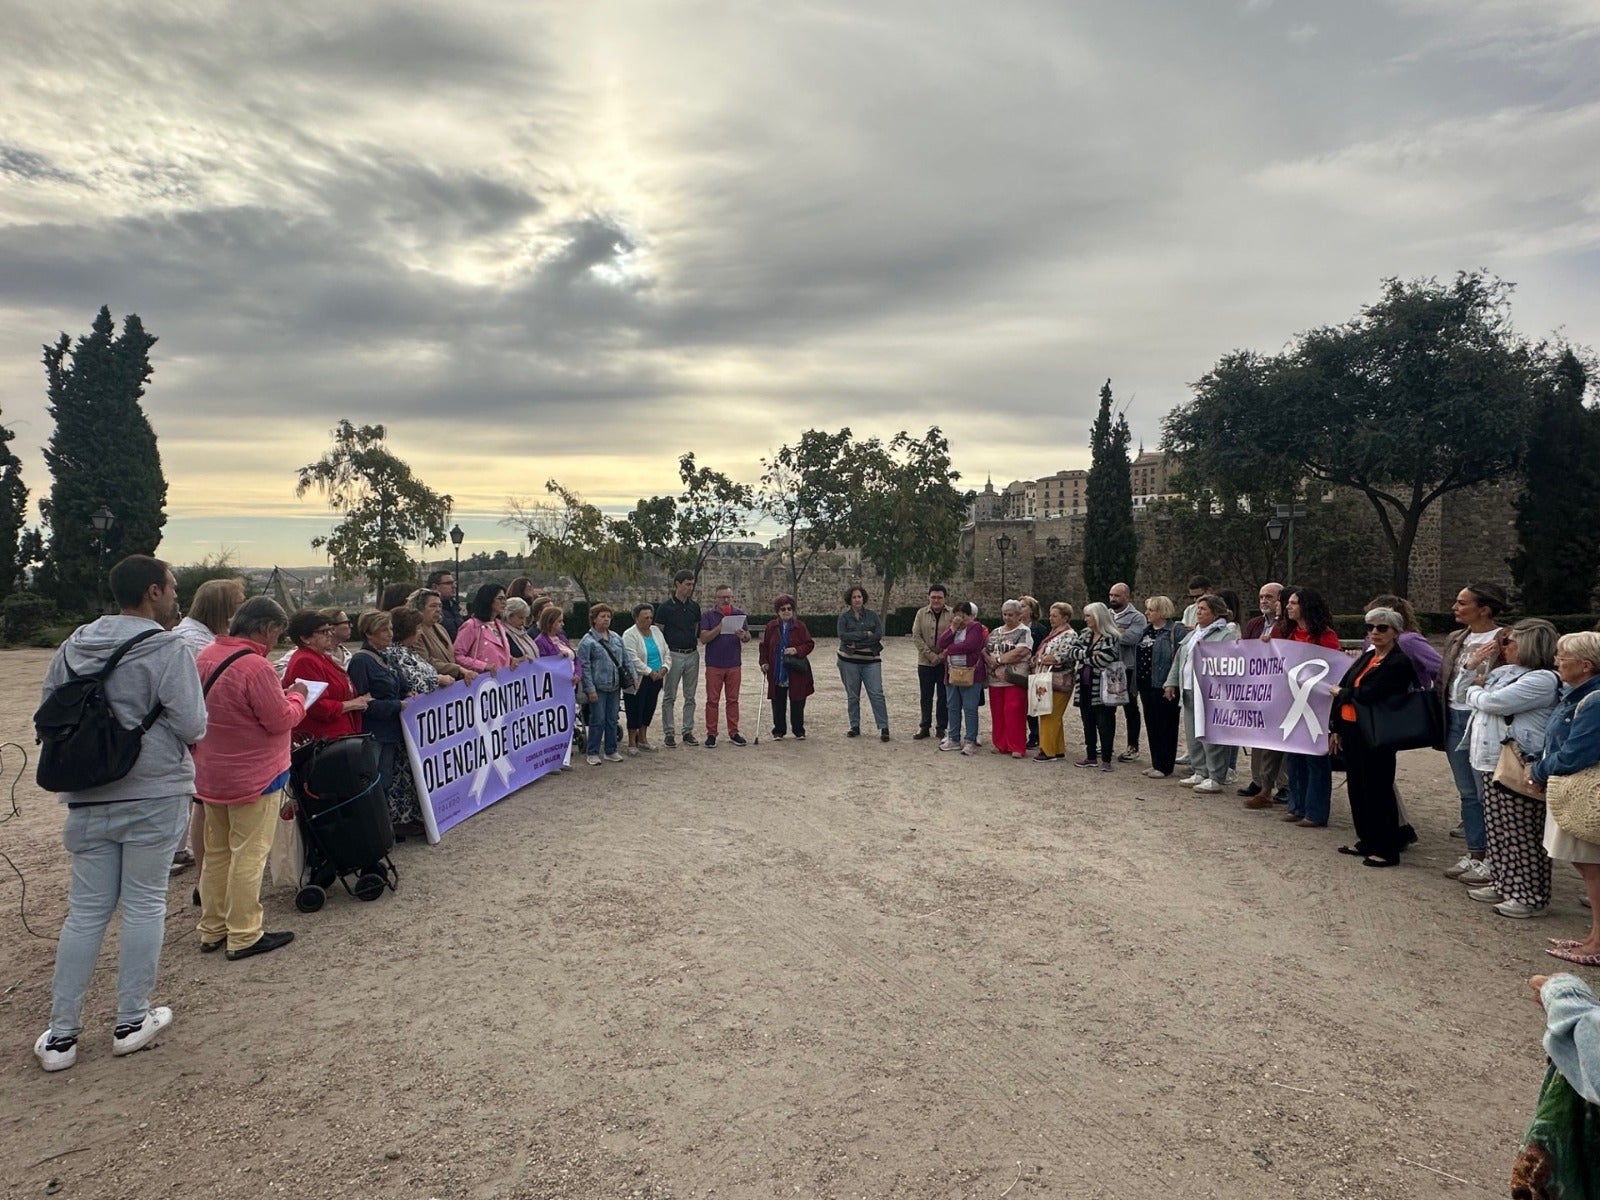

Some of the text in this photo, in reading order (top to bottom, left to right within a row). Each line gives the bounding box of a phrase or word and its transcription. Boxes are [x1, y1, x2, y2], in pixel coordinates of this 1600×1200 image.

[1201, 657, 1286, 677] TOLEDO CONTRA
[1208, 684, 1272, 702] LA VIOLENCIA
[417, 672, 553, 747] TOLEDO CONTRA LA
[1212, 708, 1265, 729] MACHISTA
[423, 705, 568, 794] OLENCIA DE GÉNERO
[539, 760, 545, 768] LA
[545, 754, 561, 765] MUJER
